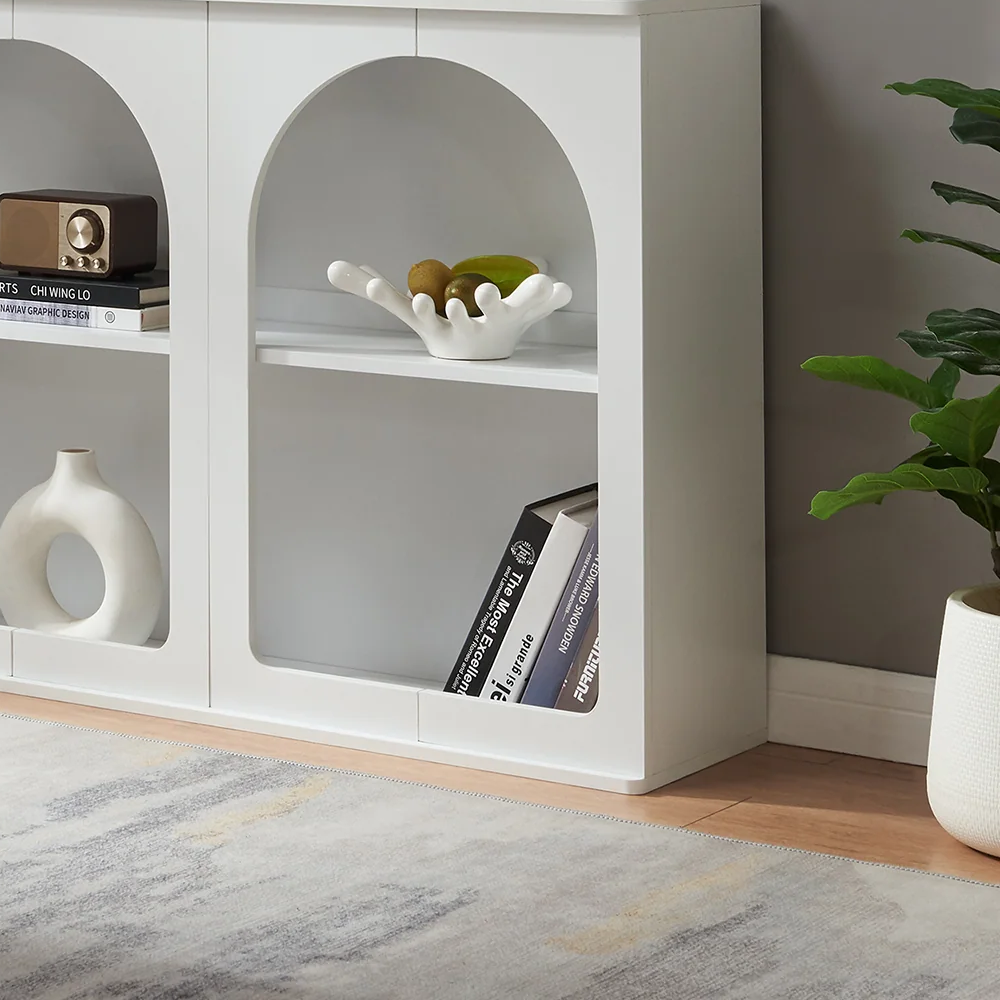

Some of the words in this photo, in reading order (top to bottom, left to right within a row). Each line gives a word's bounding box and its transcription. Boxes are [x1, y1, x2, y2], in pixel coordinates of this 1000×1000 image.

[30, 285, 47, 297] CHI
[49, 286, 76, 300] WING
[77, 289, 91, 301] LO
[27, 306, 61, 318] GRAPHIC
[61, 309, 90, 320] DESIGN
[503, 565, 512, 579] and
[503, 571, 524, 597] The
[578, 562, 600, 605] EDWARD
[488, 577, 508, 611] Lamentable
[476, 611, 493, 635] Tragedy
[486, 597, 511, 634] Most
[473, 634, 480, 643] of
[558, 603, 584, 654] SNOWDEN
[463, 640, 478, 663] Romeo
[505, 673, 517, 687] si
[511, 634, 534, 676] grande
[456, 633, 494, 696] Excellent
[458, 661, 467, 675] and
[451, 673, 462, 690] Juliet
